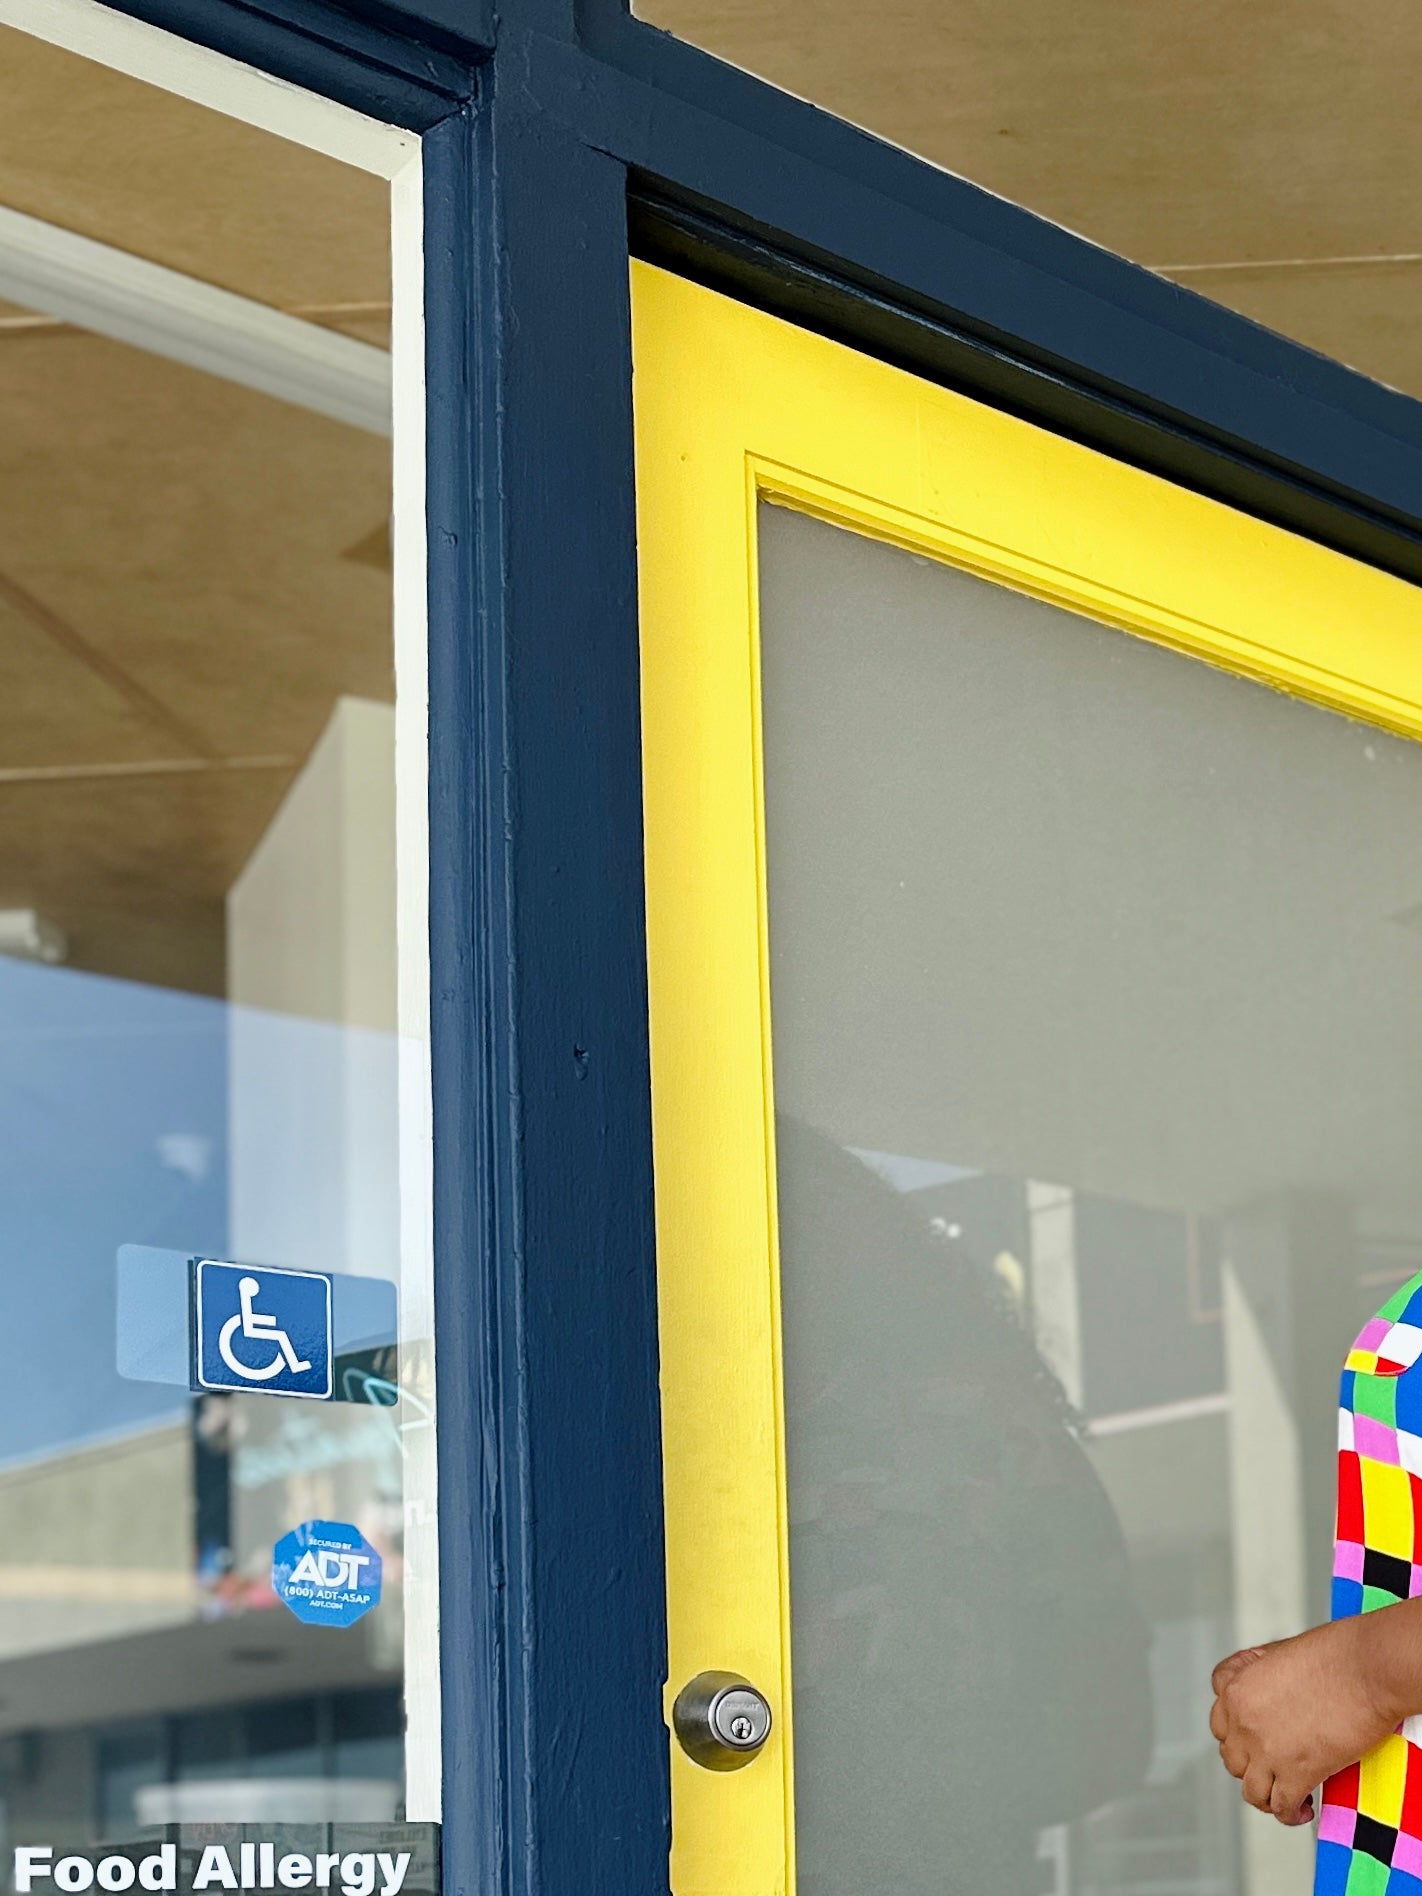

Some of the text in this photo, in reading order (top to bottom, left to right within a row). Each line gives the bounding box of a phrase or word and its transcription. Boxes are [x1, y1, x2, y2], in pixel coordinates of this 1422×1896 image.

[308, 1538, 342, 1550] SECURED
[288, 1549, 370, 1591] ADT
[284, 1585, 371, 1605] (800) ADT-ASAP
[14, 1843, 176, 1893] Food
